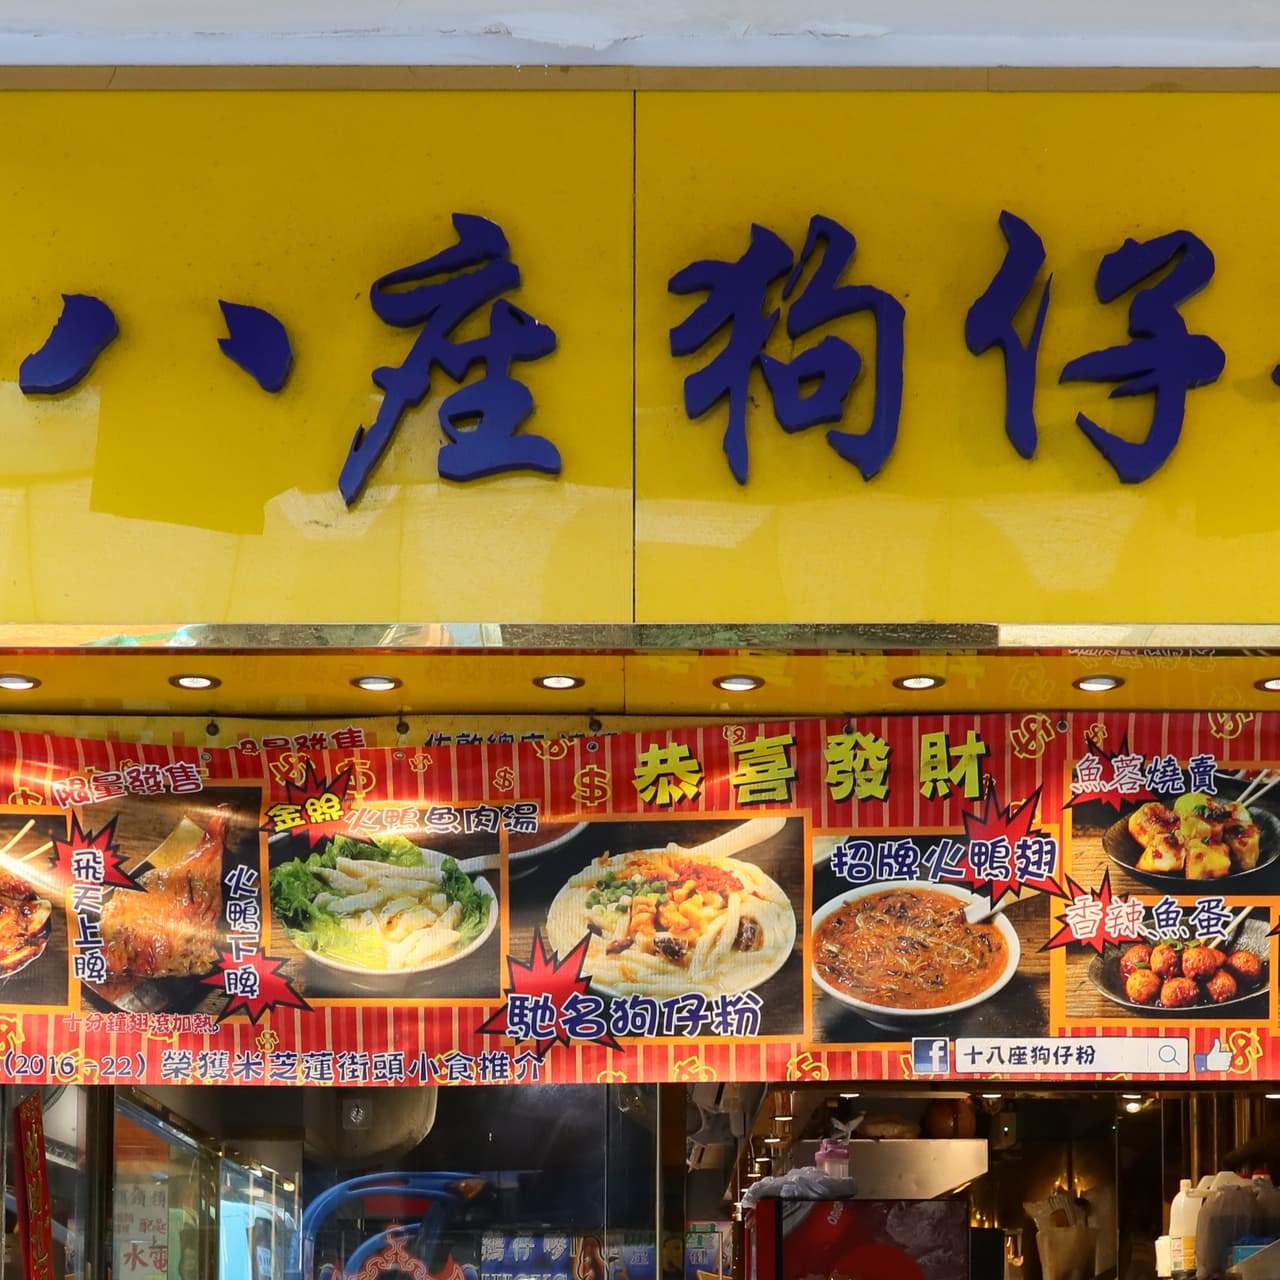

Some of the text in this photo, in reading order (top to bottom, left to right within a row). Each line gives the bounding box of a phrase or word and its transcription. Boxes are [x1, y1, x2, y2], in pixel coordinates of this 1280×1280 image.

[52, 761, 204, 811] 限量發售
[632, 729, 988, 806] 恭喜發財
[1070, 754, 1219, 795] 魚蓉燒賣
[830, 834, 1058, 884] 招牌火鴨翅
[1064, 896, 1234, 940] 香辣魚蛋
[505, 991, 763, 1041] 馳名狗仔粉
[161, 1049, 546, 1084] 榮獲米芝蓮街頭小食推介
[963, 1045, 1097, 1067] 十八座狗仔粉
